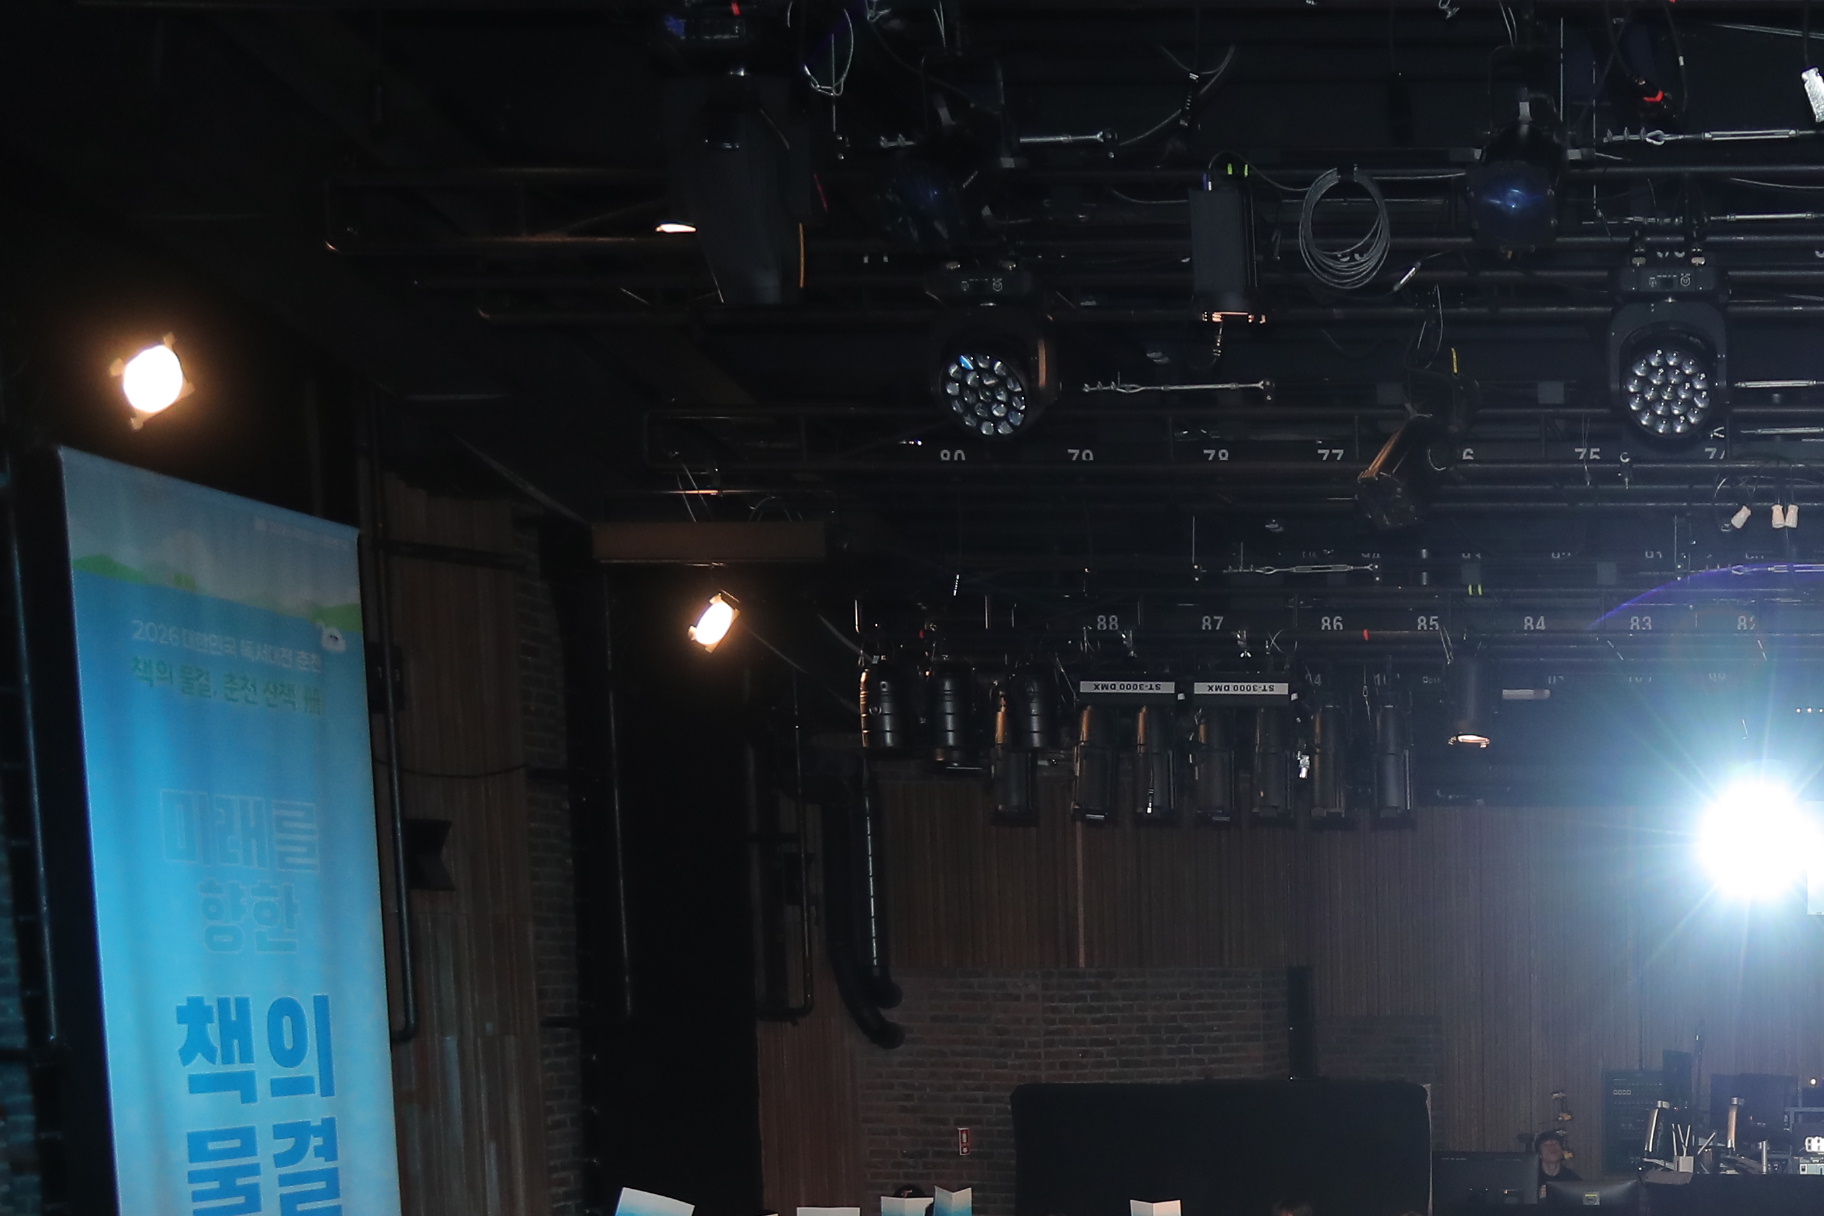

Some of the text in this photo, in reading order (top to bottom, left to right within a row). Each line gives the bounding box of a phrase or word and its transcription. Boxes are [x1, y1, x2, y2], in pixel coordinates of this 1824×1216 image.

[1096, 615, 1119, 630] 88
[1201, 615, 1224, 630] 87
[1320, 616, 1343, 630] 86
[1417, 616, 1439, 630] 85
[1523, 616, 1546, 630] 84
[1630, 616, 1652, 630] 83
[131, 618, 180, 648] 2026
[131, 654, 173, 688] 책의
[160, 789, 320, 874] 미래를
[176, 995, 336, 1104] 책의
